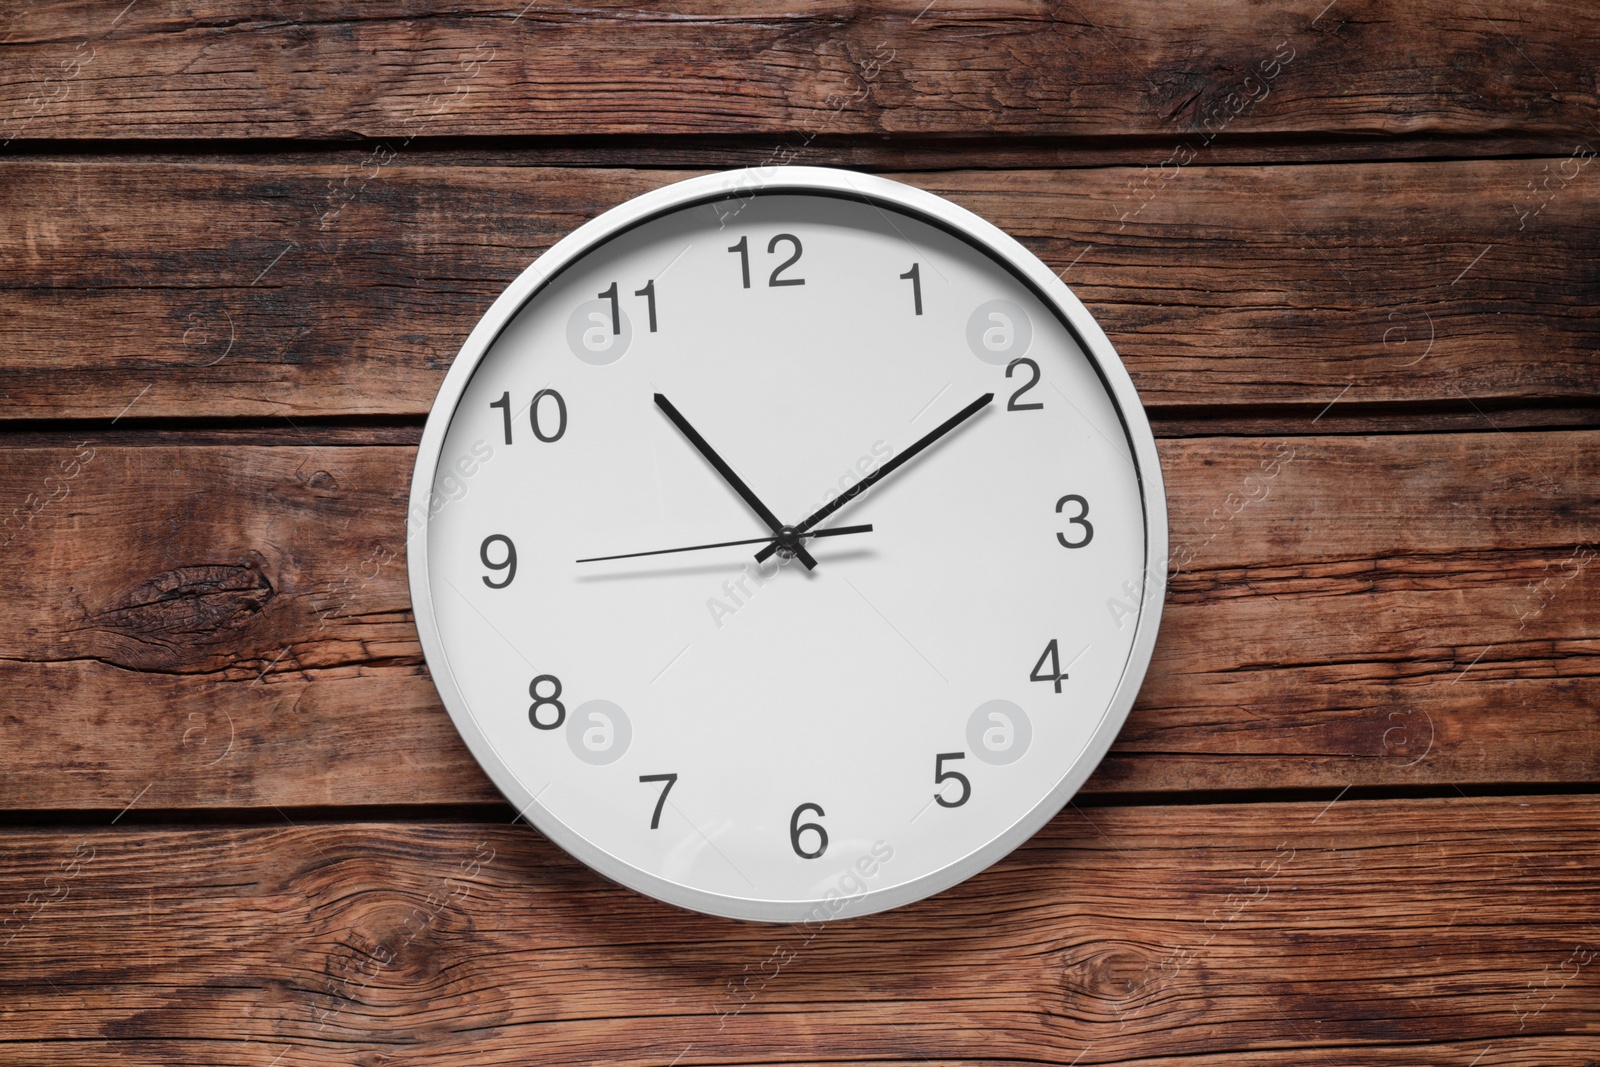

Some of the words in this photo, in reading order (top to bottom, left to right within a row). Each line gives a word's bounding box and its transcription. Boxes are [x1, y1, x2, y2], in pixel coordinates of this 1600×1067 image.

[728, 234, 805, 288] 12
[598, 280, 658, 335] 11
[900, 263, 923, 316] 1
[1006, 358, 1044, 412] 2
[490, 389, 567, 445] 10
[1056, 495, 1094, 549] 3
[480, 534, 517, 589] 9
[1030, 639, 1069, 694] 4
[529, 675, 566, 730] 8
[639, 774, 678, 830] 7
[934, 752, 972, 808] 5
[790, 803, 829, 860] 6
